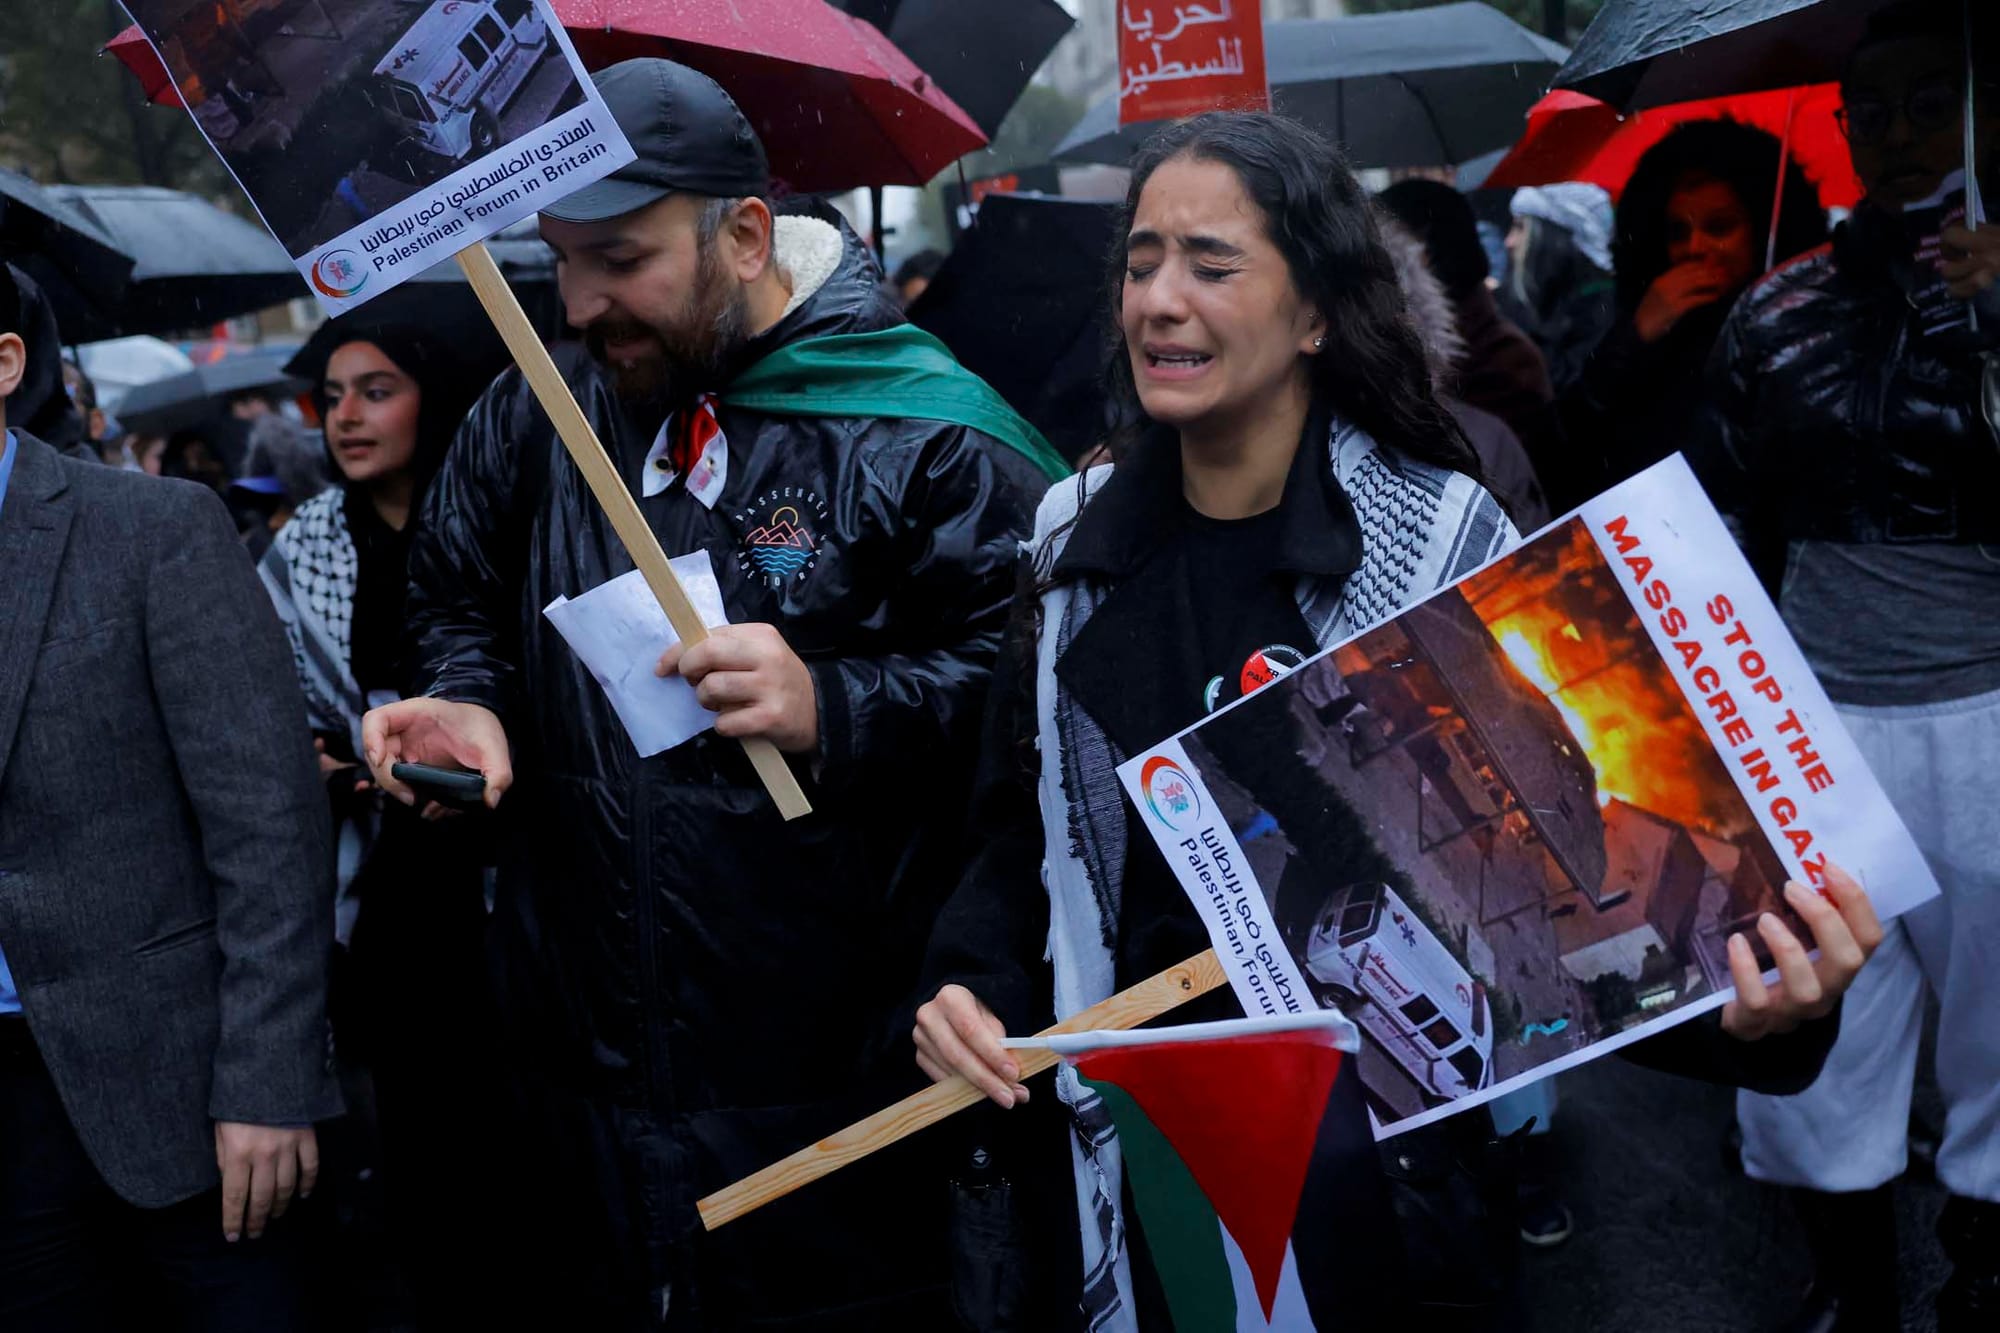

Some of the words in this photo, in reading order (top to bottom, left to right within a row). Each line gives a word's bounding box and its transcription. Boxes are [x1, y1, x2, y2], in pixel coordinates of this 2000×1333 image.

[536, 117, 597, 163] المنتدى
[372, 218, 465, 273] Palestinian
[466, 188, 521, 223] Forum
[522, 176, 541, 195] in
[542, 140, 608, 182] Britain
[417, 192, 445, 229] في
[449, 148, 536, 210] الفلسطيني
[359, 213, 417, 255] بريطانيا
[1604, 514, 1754, 748] MASSACRE
[1739, 748, 1781, 793] IN
[1706, 593, 1783, 706] STOP
[1775, 708, 1835, 793] THE
[1199, 826, 1242, 894] بريطانيا
[1180, 837, 1245, 956] Palestinian
[1236, 896, 1262, 940] في
